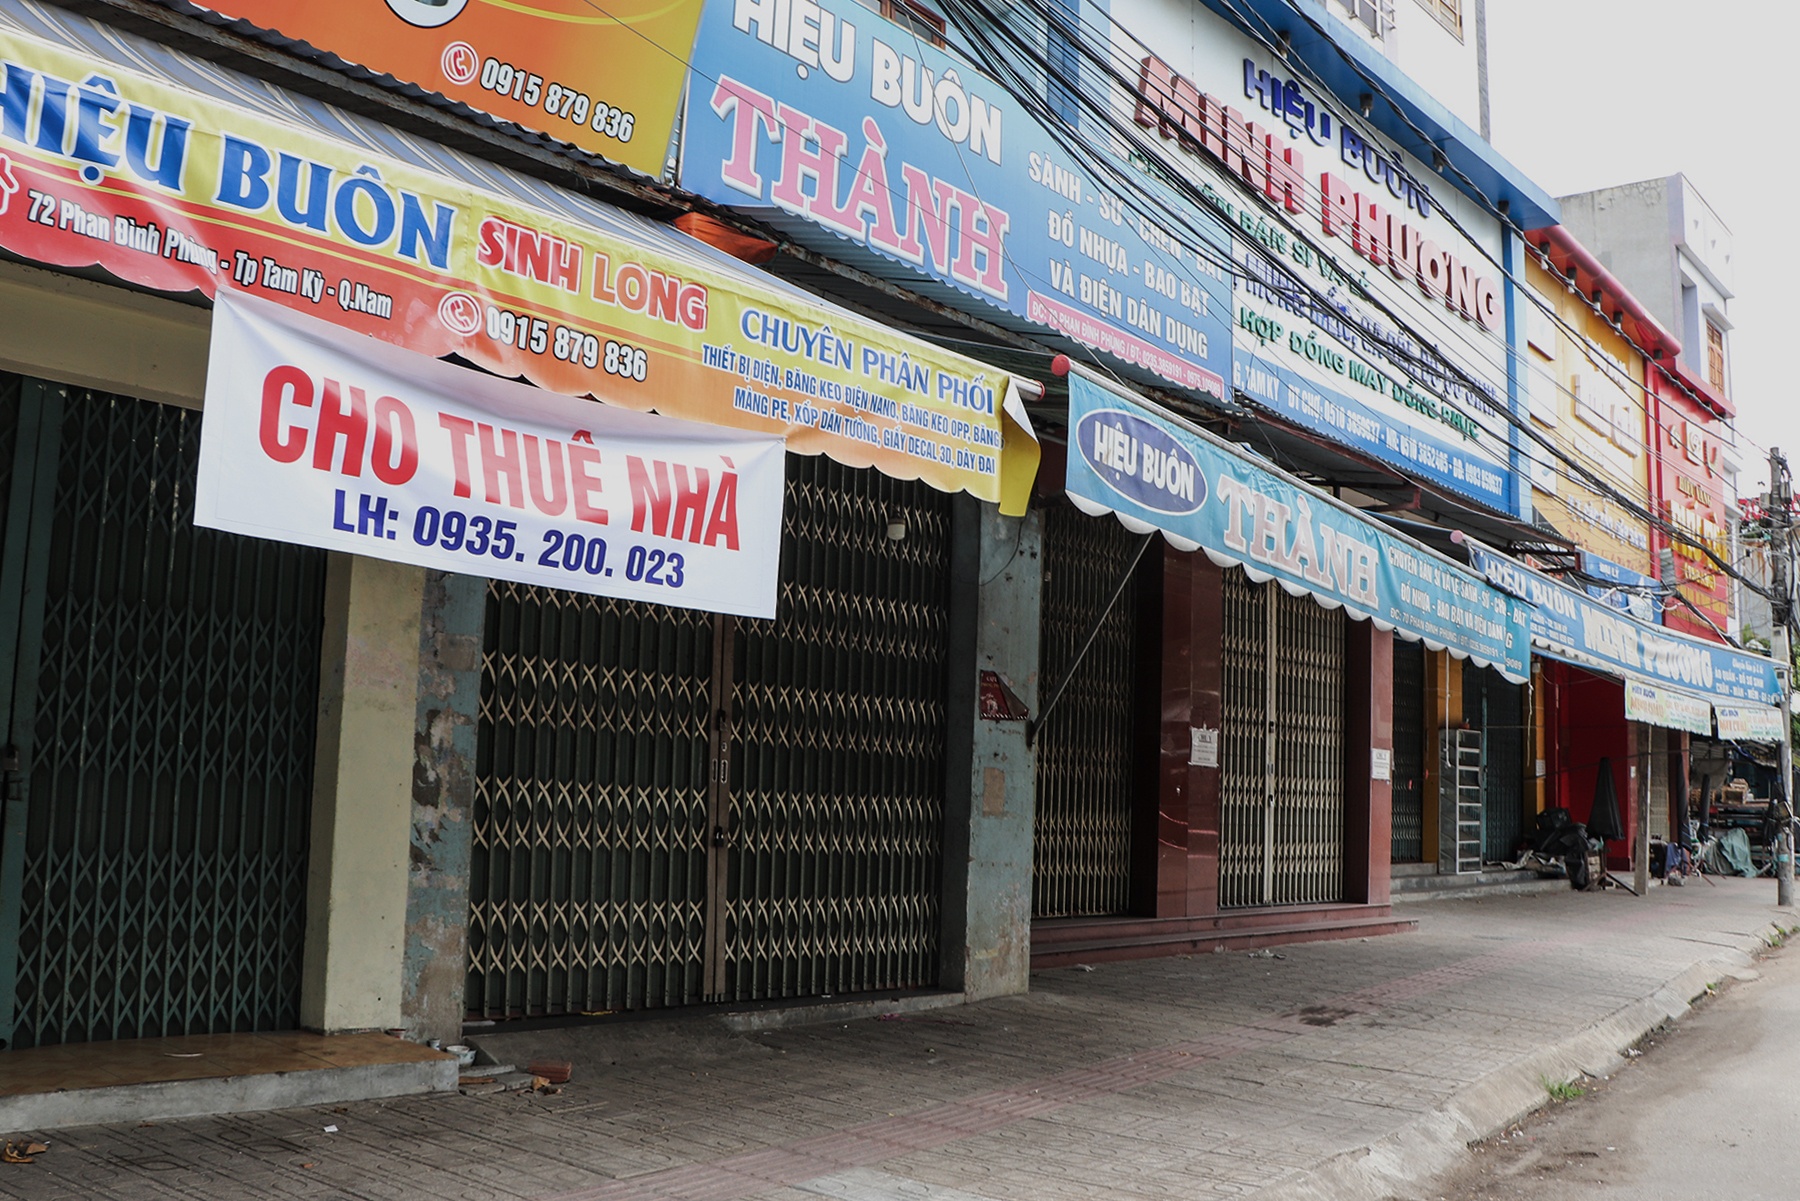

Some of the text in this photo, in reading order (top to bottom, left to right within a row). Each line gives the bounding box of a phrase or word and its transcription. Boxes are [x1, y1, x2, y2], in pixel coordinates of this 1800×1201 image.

[480, 57, 635, 143] 0915 879 836
[870, 36, 1003, 167] BUÔN
[1243, 58, 1332, 148] HIỆU
[214, 131, 459, 272] BUÔN
[710, 73, 1010, 301] THÀNH
[1028, 151, 1082, 206] SÀNH
[1134, 55, 1306, 216] MINH
[1320, 171, 1502, 333] PHƯƠNG
[28, 188, 57, 228] 72
[58, 197, 111, 242] Phan
[113, 214, 161, 256] Đình
[163, 227, 219, 276] Phùng
[233, 251, 259, 288] Tp
[262, 256, 299, 295] Tam
[300, 267, 325, 304] Kỳ
[338, 278, 393, 320] Q.Nam
[476, 214, 709, 333] SINH LONG
[1048, 208, 1074, 248] ĐỒ
[1079, 225, 1129, 278] NHỰA
[1144, 259, 1176, 301] BAO
[1181, 281, 1210, 318] BẠT
[485, 305, 648, 383] 0915 879 836
[1032, 301, 1047, 321] ĐC:
[1059, 314, 1081, 337] PHAN
[1081, 320, 1100, 344] ĐÌNH
[1100, 331, 1126, 354] PHÙNG
[1050, 258, 1208, 360] VÀ ĐIỆN DÂN DỤNG
[1241, 306, 1285, 347] HỢP
[1349, 359, 1389, 395] MAY
[702, 342, 1001, 450] THIẾT BỊ ĐIỆN, BĂNG KEO ĐIỆN NANO, BĂNG KEO OPP, BĂNG
[740, 309, 995, 416] CHUYÊN PHÂN PHỐI
[257, 364, 742, 552] CHO THUÊ NHÀ
[733, 386, 997, 476] MÀNG PE, XỐP DÁN TƯỜNG, GIẤY DECAL 3D, DÂY ĐAI
[1094, 421, 1195, 503] HIỆU BUÔN
[1324, 399, 1345, 430] 0510
[332, 489, 685, 590] LH: 0935. 200. 023
[1216, 473, 1380, 611] THÀNH
[1485, 557, 1527, 599] HIỆU
[1530, 578, 1577, 620] BUÔN
[1451, 604, 1465, 628] BẠT
[1580, 602, 1642, 668] MINH
[1640, 629, 1713, 689] PHƯƠNG
